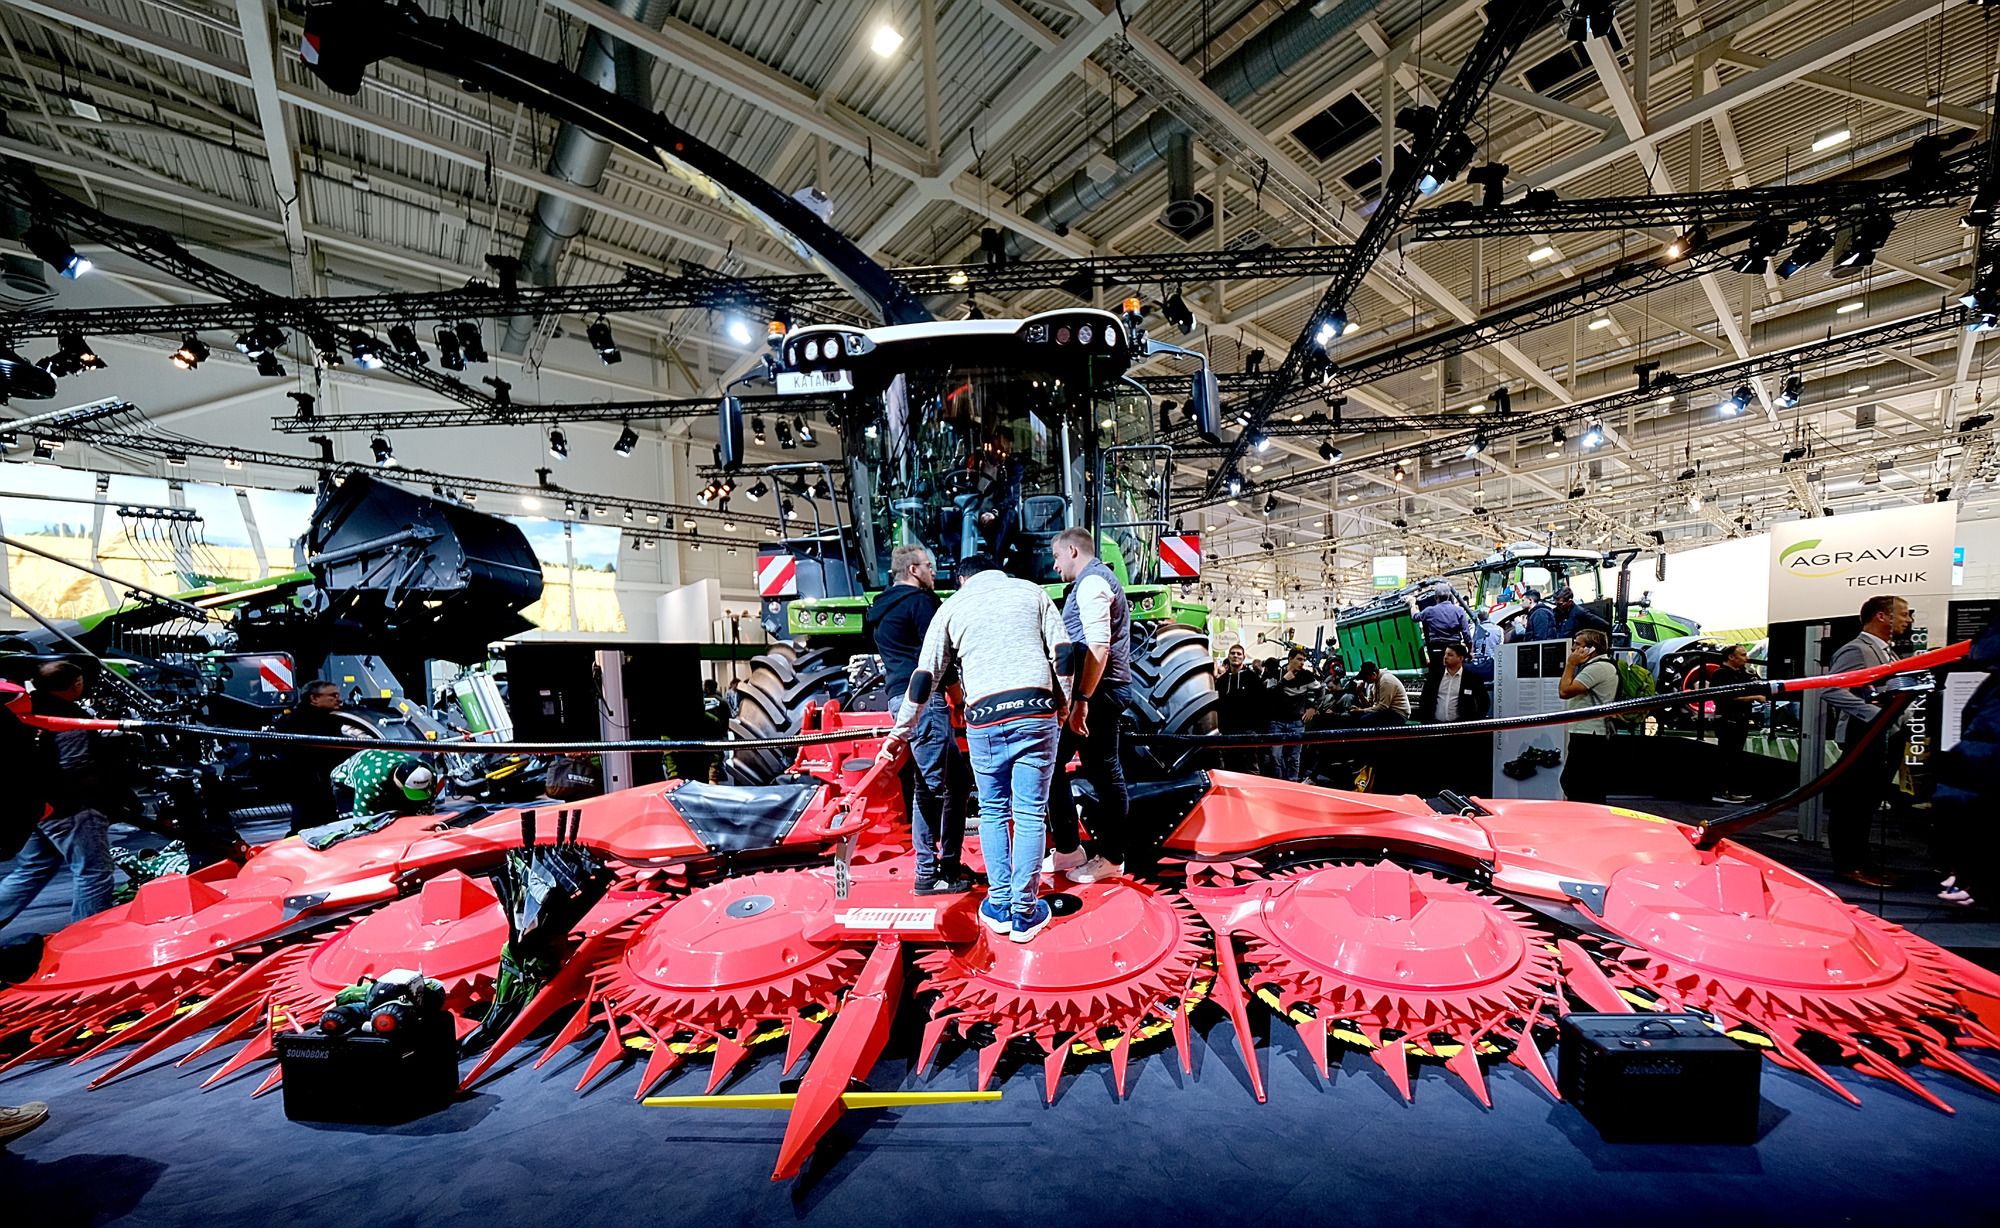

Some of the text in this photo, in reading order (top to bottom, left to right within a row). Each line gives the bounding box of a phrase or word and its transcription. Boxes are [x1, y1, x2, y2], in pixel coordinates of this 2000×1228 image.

[793, 373, 837, 389] KATANA
[1790, 544, 1930, 568] AGRAVIS
[1845, 571, 1928, 587] TECHNIK
[995, 699, 1025, 712] STEYR
[1905, 716, 1927, 766] Fendt
[286, 1048, 330, 1060] SOUNDBOKS
